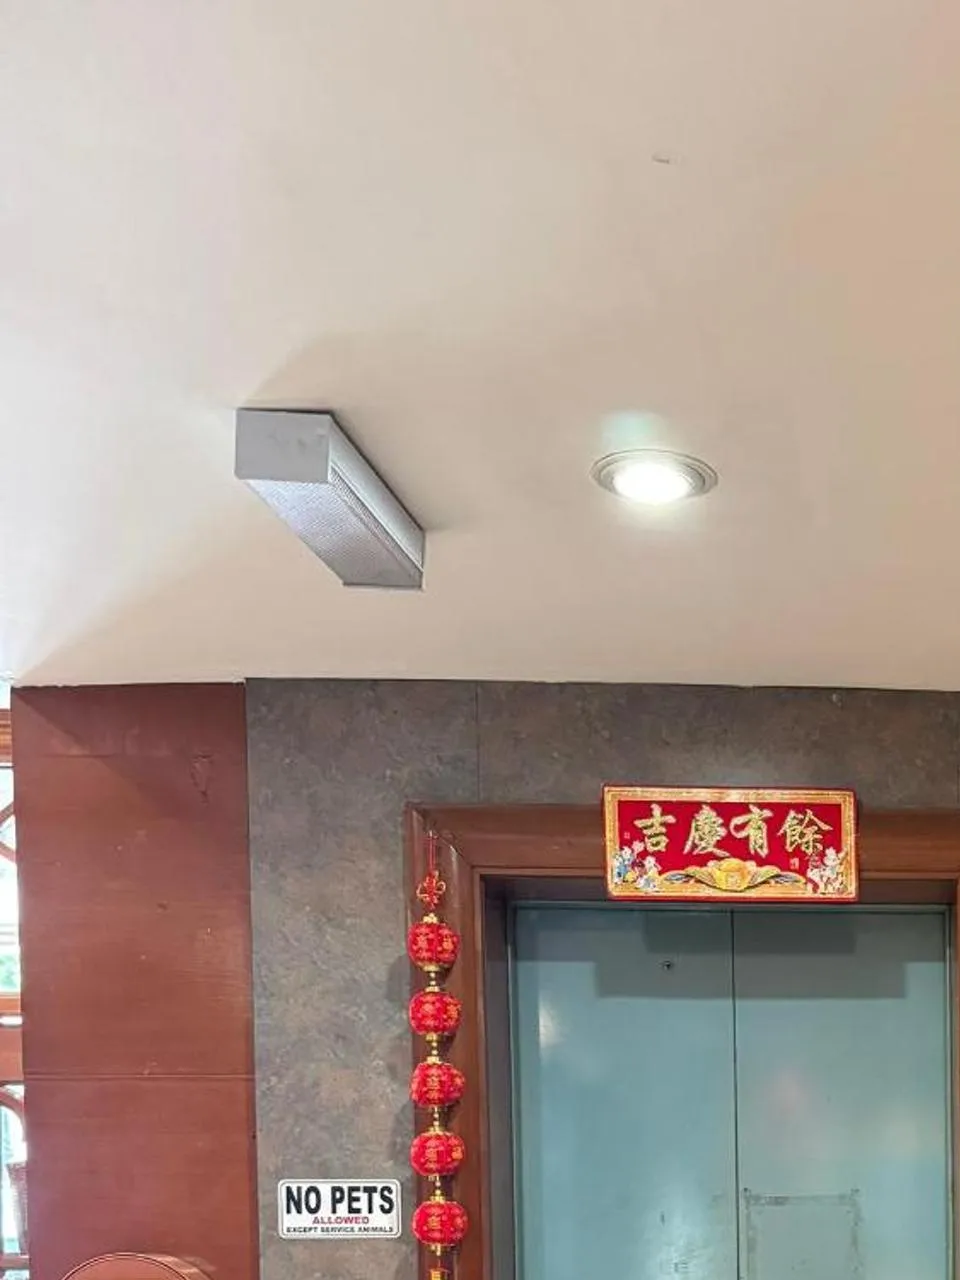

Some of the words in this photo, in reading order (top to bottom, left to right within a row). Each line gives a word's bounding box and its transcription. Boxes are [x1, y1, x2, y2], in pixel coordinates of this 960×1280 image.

[634, 803, 833, 858] 吉慶有餘
[285, 1185, 322, 1215] NO
[331, 1185, 394, 1215] PETS
[312, 1216, 370, 1225] ALLOWED
